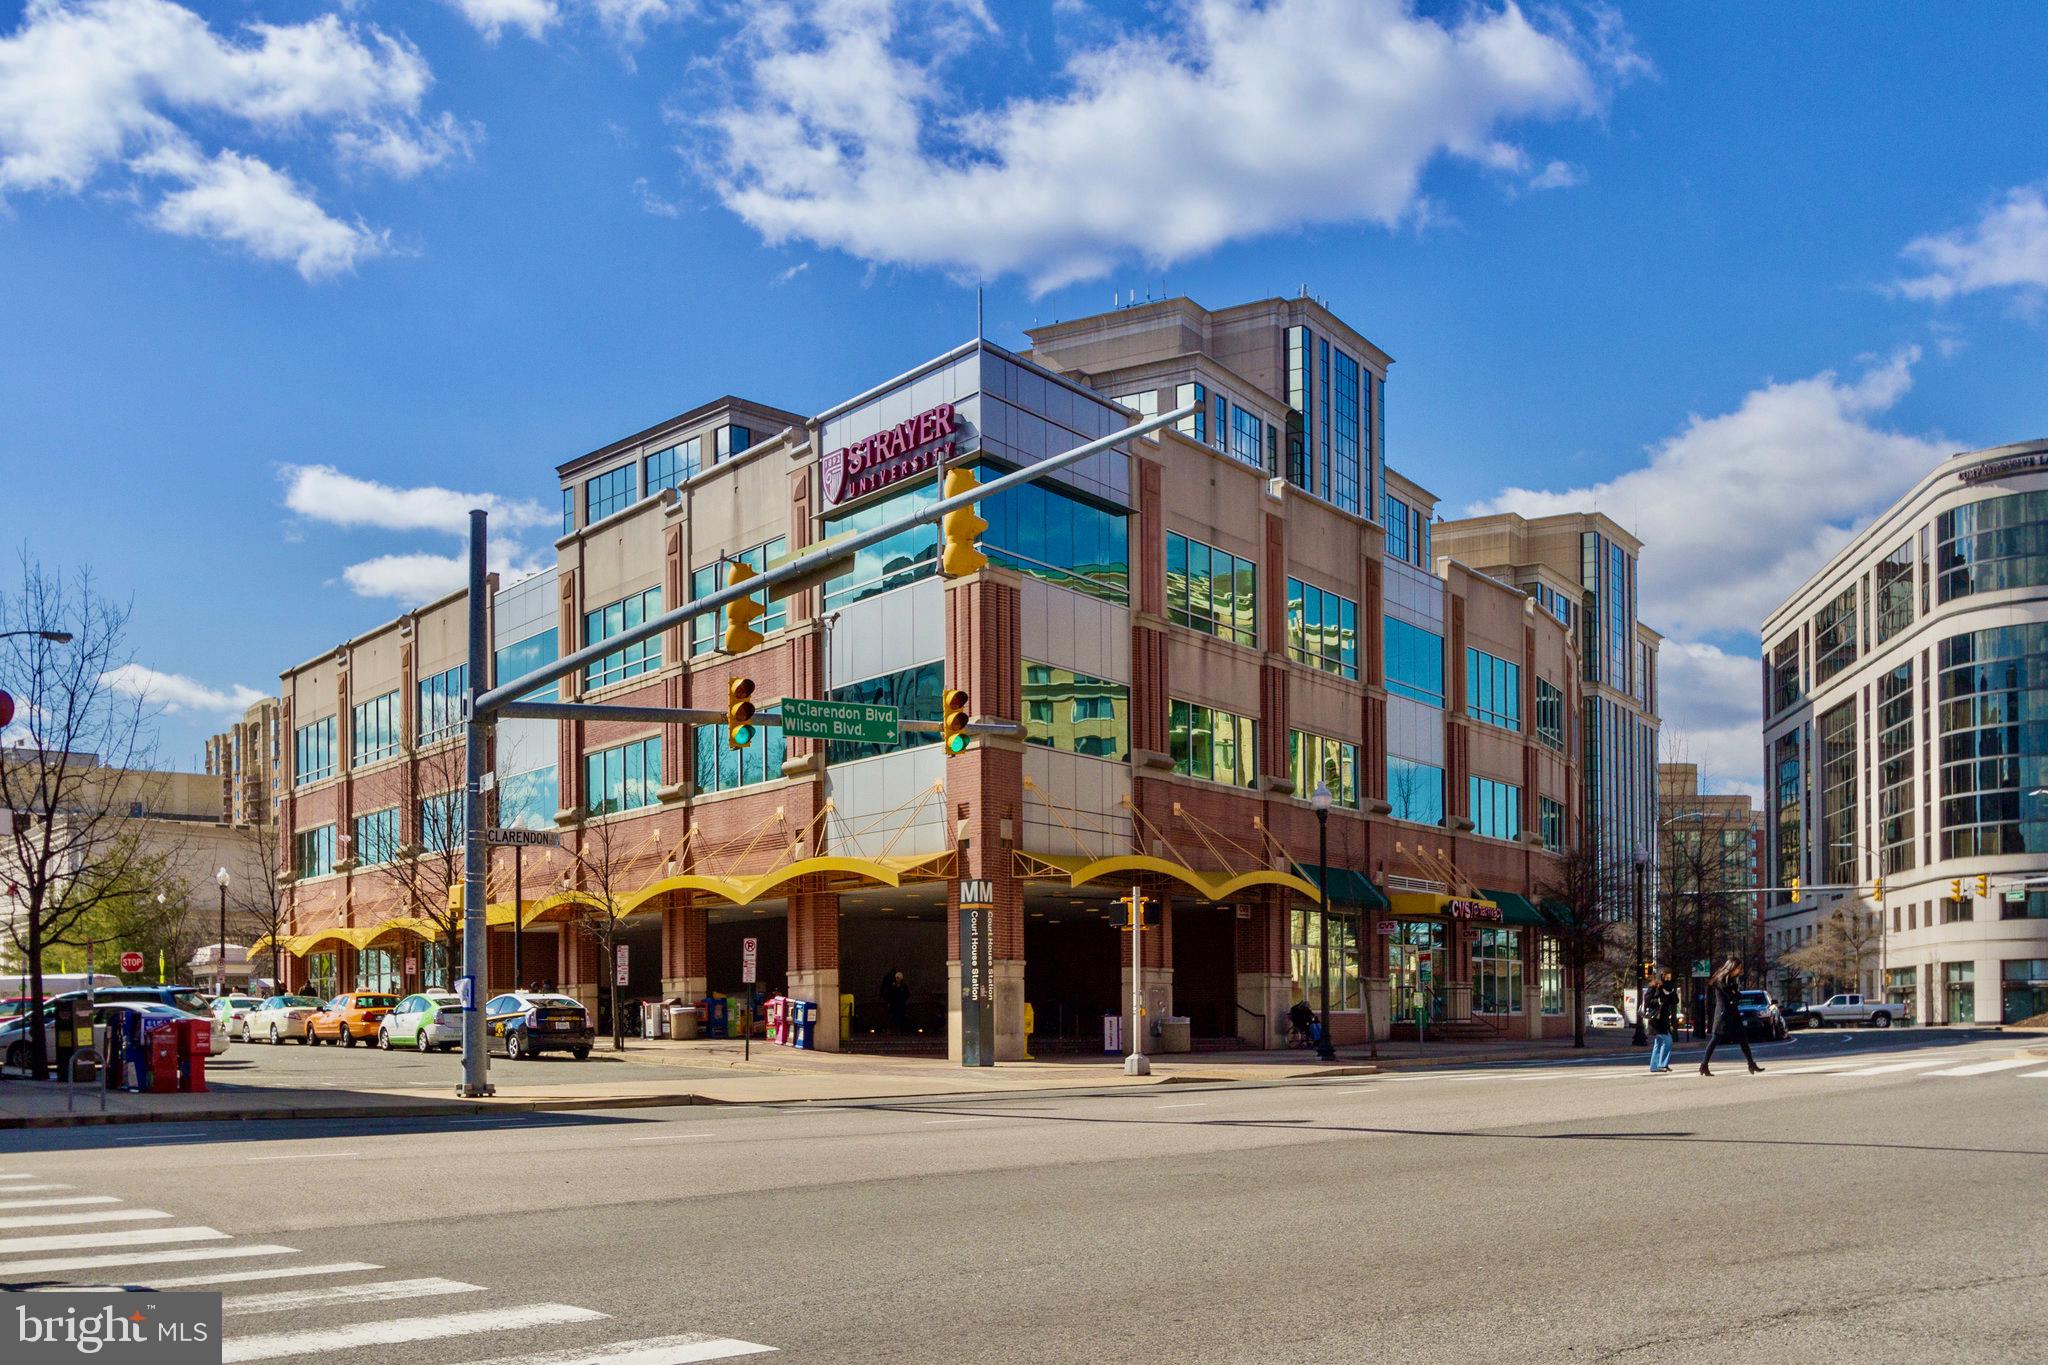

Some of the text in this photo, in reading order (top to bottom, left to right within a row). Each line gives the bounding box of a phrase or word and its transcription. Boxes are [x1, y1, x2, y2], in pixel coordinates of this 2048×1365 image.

[848, 403, 956, 475] STRAYER
[849, 442, 956, 497] UNIVERSITY
[797, 703, 896, 723] Clarendon Blvd.
[784, 717, 866, 736] Wilson Blvd.
[488, 830, 549, 845] CLARENDON
[1378, 922, 1395, 930] CVS
[1463, 930, 1478, 938] CVS
[122, 958, 142, 967] STOP
[971, 911, 979, 1001] Court House Station
